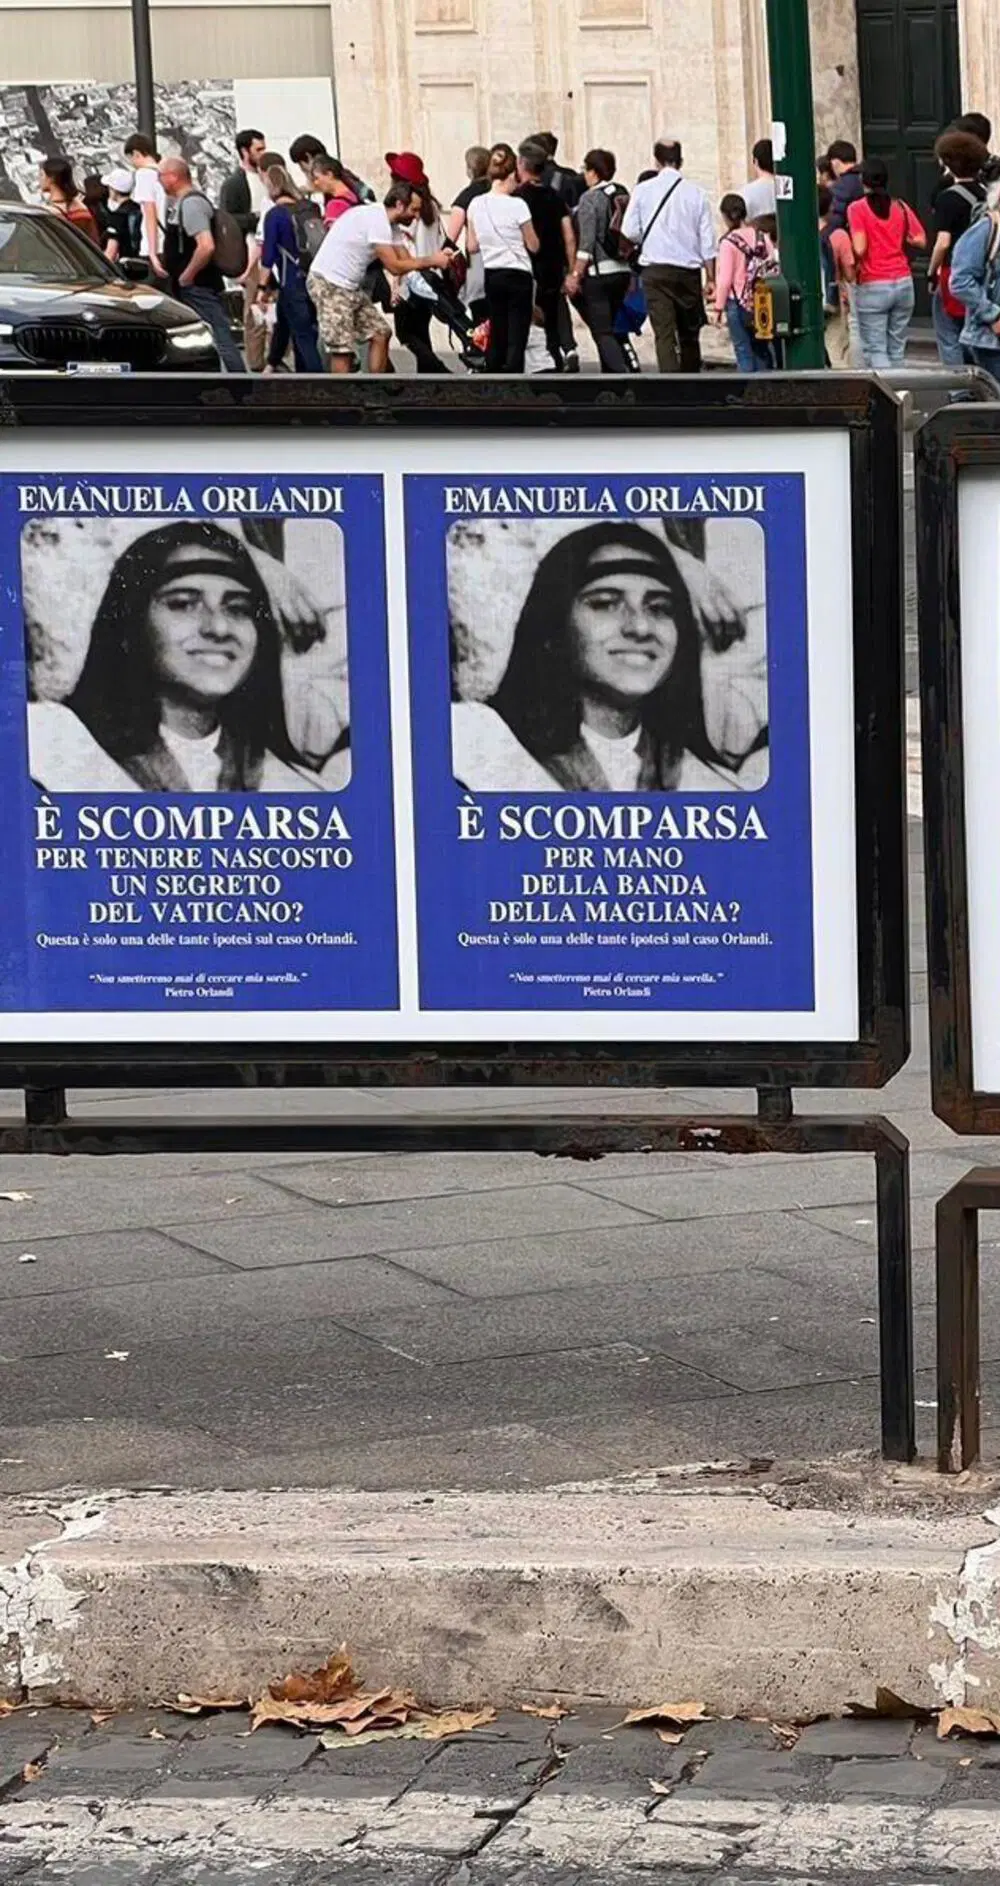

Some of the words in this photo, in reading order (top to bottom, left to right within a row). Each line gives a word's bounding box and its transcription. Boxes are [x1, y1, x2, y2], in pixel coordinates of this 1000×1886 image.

[17, 485, 195, 513] EMANUELA
[202, 486, 344, 513] ORLANDI
[443, 486, 618, 513] EMANUELA
[625, 486, 765, 513] ORLANDI
[33, 795, 63, 840] È
[78, 805, 352, 841] SCOMPARSA
[456, 794, 485, 840] È
[499, 805, 768, 840] SCOMPARSA
[35, 847, 88, 869] PER
[95, 847, 203, 869] TENERE
[210, 847, 353, 869] NASCOSTO
[544, 847, 595, 868] PER
[603, 846, 683, 869] MANO
[110, 874, 147, 897] UN
[155, 874, 281, 897] SEGRETO
[522, 874, 609, 896] DELLA
[617, 874, 707, 896] BANDA
[89, 901, 142, 923] DEL
[150, 901, 304, 923] VATICANO?
[489, 901, 577, 923] DELLA
[584, 901, 740, 923] MAGLIANA?
[35, 933, 80, 949] Questa
[82, 932, 90, 946] è
[92, 933, 118, 946] solo
[120, 936, 144, 946] una
[146, 932, 176, 946] delle
[178, 934, 210, 945] tante
[212, 932, 253, 948] ipotesi
[255, 932, 274, 945] sul
[276, 935, 303, 945] caso
[305, 932, 358, 946] Orlandi.
[457, 932, 500, 947] Questa
[502, 931, 510, 945] è
[512, 932, 538, 945] solo
[540, 935, 563, 945] una
[565, 932, 595, 945] delle
[597, 933, 628, 945] tante
[630, 932, 669, 948] ipotesi
[672, 932, 690, 945] sul
[692, 936, 720, 945] caso
[722, 932, 773, 946] Orlandi.
[165, 987, 195, 997] Pietro
[195, 986, 234, 997] Orlandi
[583, 986, 612, 997] Pietro
[613, 986, 651, 997] Orlandi
